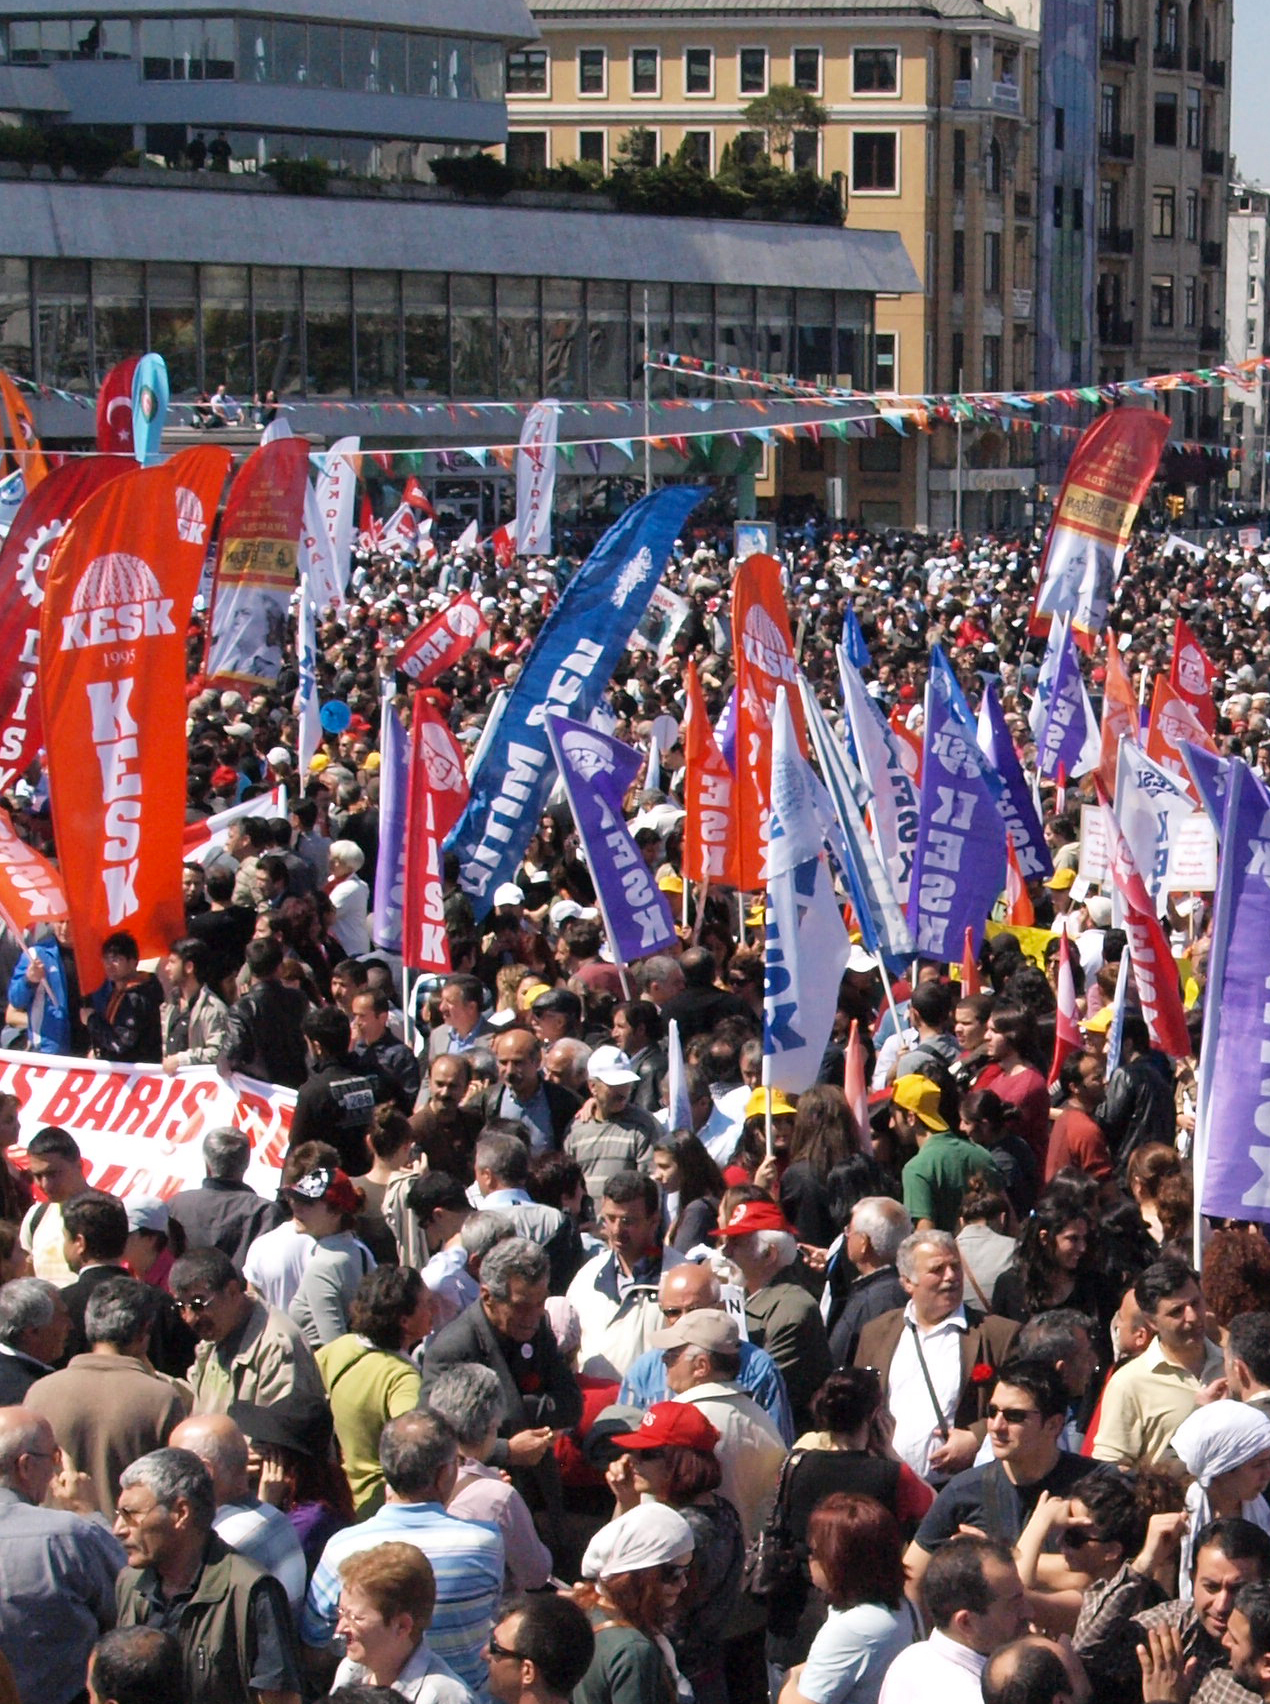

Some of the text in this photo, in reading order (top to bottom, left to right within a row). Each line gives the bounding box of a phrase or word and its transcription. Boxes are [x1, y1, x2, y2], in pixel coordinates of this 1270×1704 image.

[177, 518, 207, 545] SK
[59, 598, 177, 652] KESK
[102, 648, 137, 669] 1995
[402, 627, 456, 679] KES
[86, 676, 143, 927] KESK
[995, 774, 1045, 878] ESK
[1125, 909, 1161, 1045] ESK
